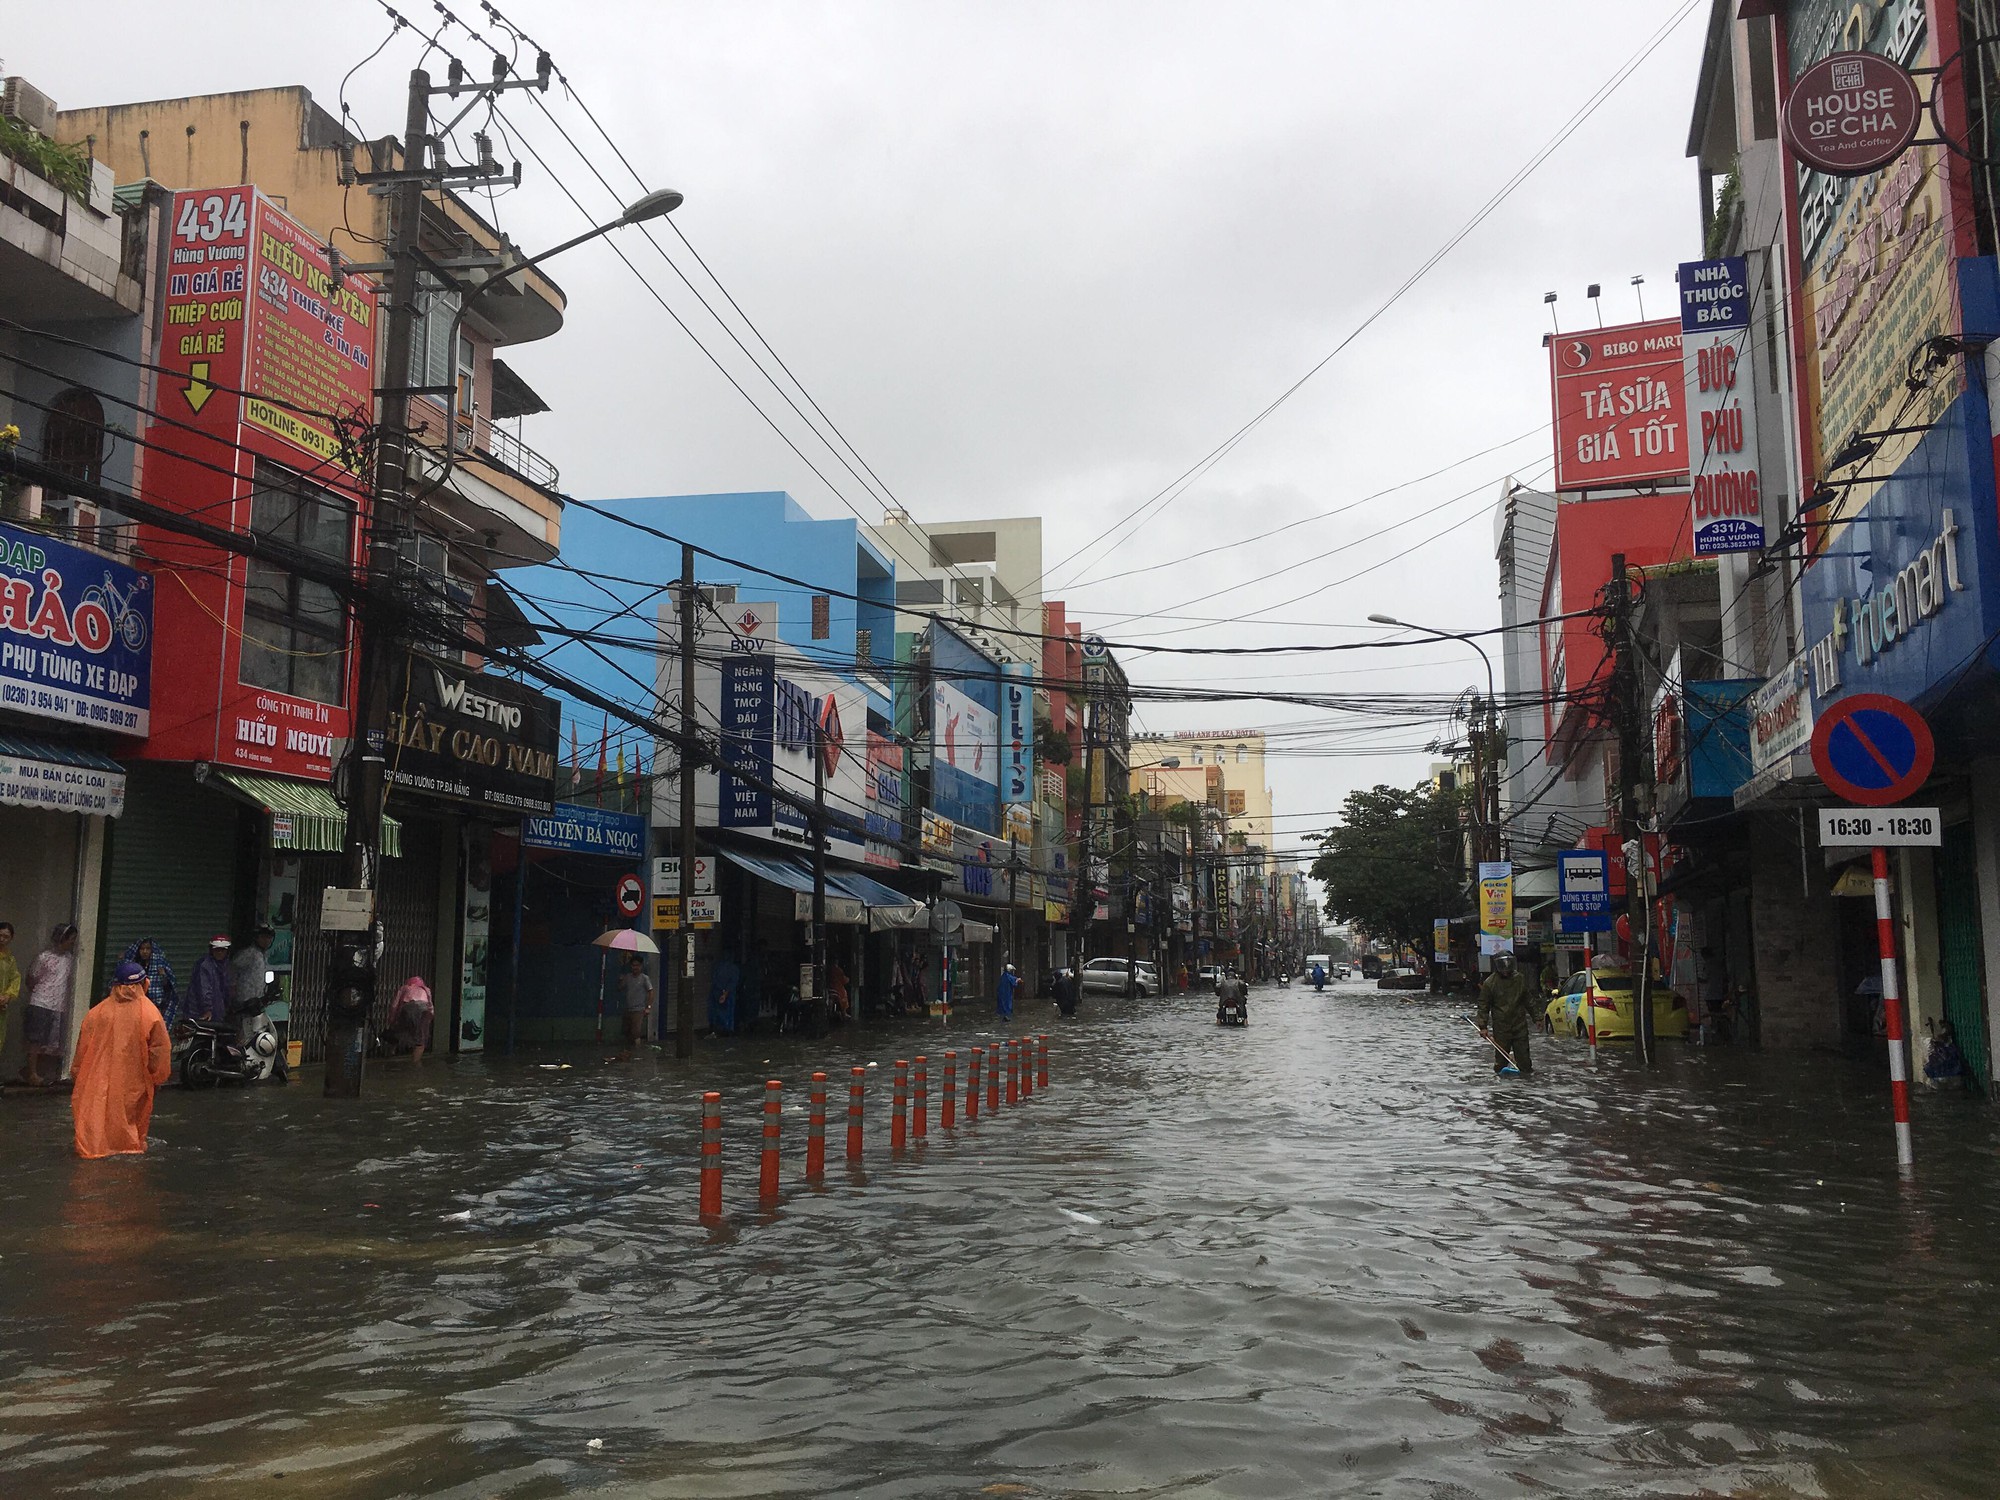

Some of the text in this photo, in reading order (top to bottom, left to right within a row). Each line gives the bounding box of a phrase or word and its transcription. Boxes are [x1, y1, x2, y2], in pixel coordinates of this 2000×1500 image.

[1834, 64, 1860, 76] HOUSE
[1841, 74, 1861, 87] CHA
[1807, 88, 1895, 117] HOUSE
[1809, 112, 1897, 136] OF CHA
[1818, 137, 1891, 152] Tea And Coffee
[176, 194, 248, 243] 434
[265, 211, 284, 231] CÔNG
[285, 224, 293, 237] TY
[173, 245, 245, 264] Hùng Vương
[171, 265, 244, 296] IN GIÁ RẺ
[262, 231, 371, 327] HIẾU NGUYÊN
[1694, 262, 1730, 283] NHÀ
[260, 265, 345, 335] 434 THIẾT KẾ
[1684, 281, 1744, 304] THUỐC
[169, 297, 242, 327] THIỆP CƯỚI
[1697, 304, 1733, 323] BẮC
[180, 328, 225, 355] GIÁ RẺ
[323, 329, 369, 370] & IN ẤN
[1603, 335, 1683, 357] BIBO MART
[1698, 337, 1737, 392] ĐỨC
[1581, 376, 1672, 420] TÃ SỮA
[250, 400, 298, 438] HOTLINE:
[1701, 398, 1744, 454] PHÚ
[1577, 415, 1679, 464] GIÁ TỐT
[1695, 461, 1759, 519] ĐƯỜNG
[1700, 531, 1760, 544] HÙNG VƯƠNG
[1711, 522, 1747, 535] 331/4
[731, 639, 765, 651] BIDV
[2, 642, 138, 701] PHỤ TÙNG XE ĐẠP
[734, 664, 763, 677] NGÂN
[1811, 635, 1843, 699] TH
[734, 680, 763, 692] HÀNG
[3, 683, 28, 707] (0236)
[30, 691, 37, 707] 3
[38, 691, 52, 709] 954
[54, 695, 68, 713] 941
[90, 705, 108, 723] 0905
[110, 709, 123, 727] 969
[125, 712, 138, 729] 287
[256, 694, 278, 713] CÔNG
[280, 702, 291, 716] TY
[292, 704, 313, 720] TNHH
[433, 669, 522, 733] WESTNO
[734, 698, 761, 709] TMCP
[235, 713, 278, 747] HIẾU
[777, 675, 823, 760] BIDV
[235, 747, 248, 759] 434
[452, 729, 555, 780] CAO NAM
[19, 765, 39, 779] MUA
[42, 767, 62, 782] BÁN
[64, 770, 83, 785] CÁC
[395, 770, 413, 786] HÙNG
[414, 775, 435, 790] VƯƠNG
[454, 780, 470, 797] NẴNG
[94, 795, 106, 810] CAO
[735, 791, 758, 805] VIỆT
[734, 807, 758, 819] NAM
[528, 818, 638, 851] NGUYỄN BÁ NGỌC
[1828, 818, 1872, 836] 16:30
[1888, 817, 1933, 836] 18:30
[661, 862, 680, 873] BI
[1562, 892, 1580, 902] DỪNG
[1592, 892, 1608, 901] BUÝT
[1571, 902, 1602, 911] BUS STOP
